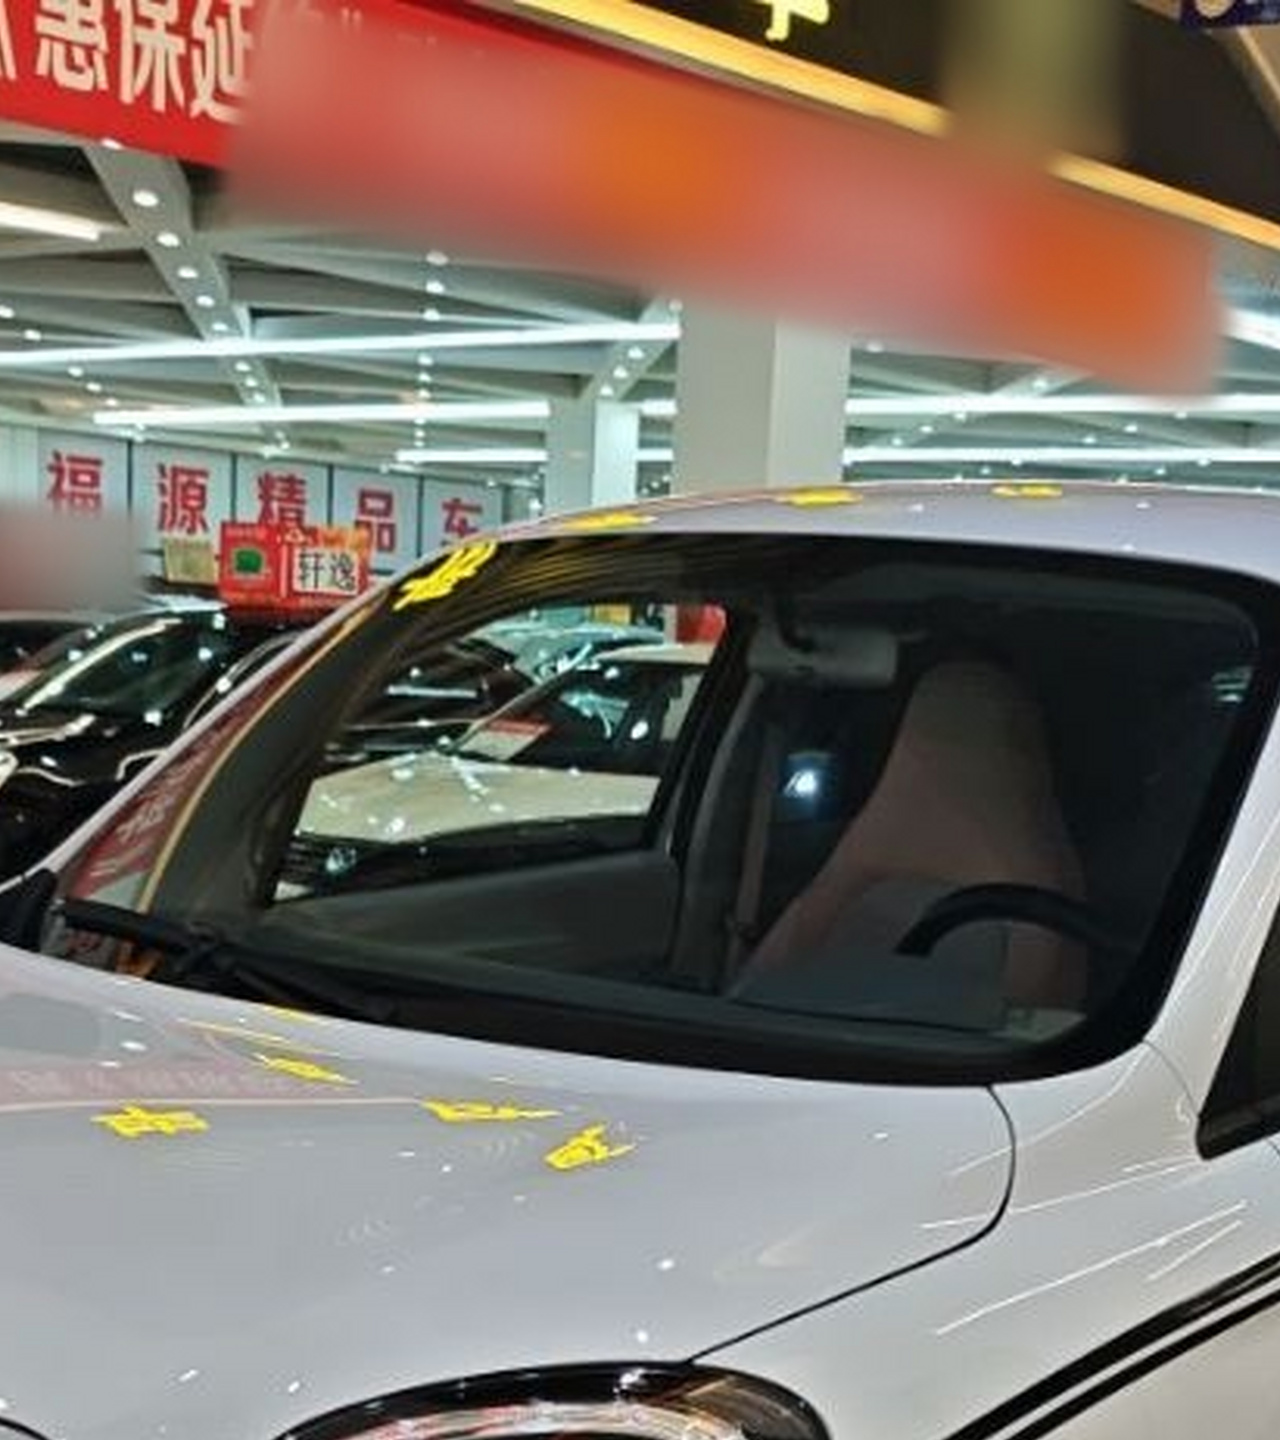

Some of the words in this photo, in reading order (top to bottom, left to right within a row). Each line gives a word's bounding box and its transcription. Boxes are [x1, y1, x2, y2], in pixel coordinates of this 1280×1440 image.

[47, 450, 484, 556] 福源精品车
[298, 548, 357, 592] 轩逸
